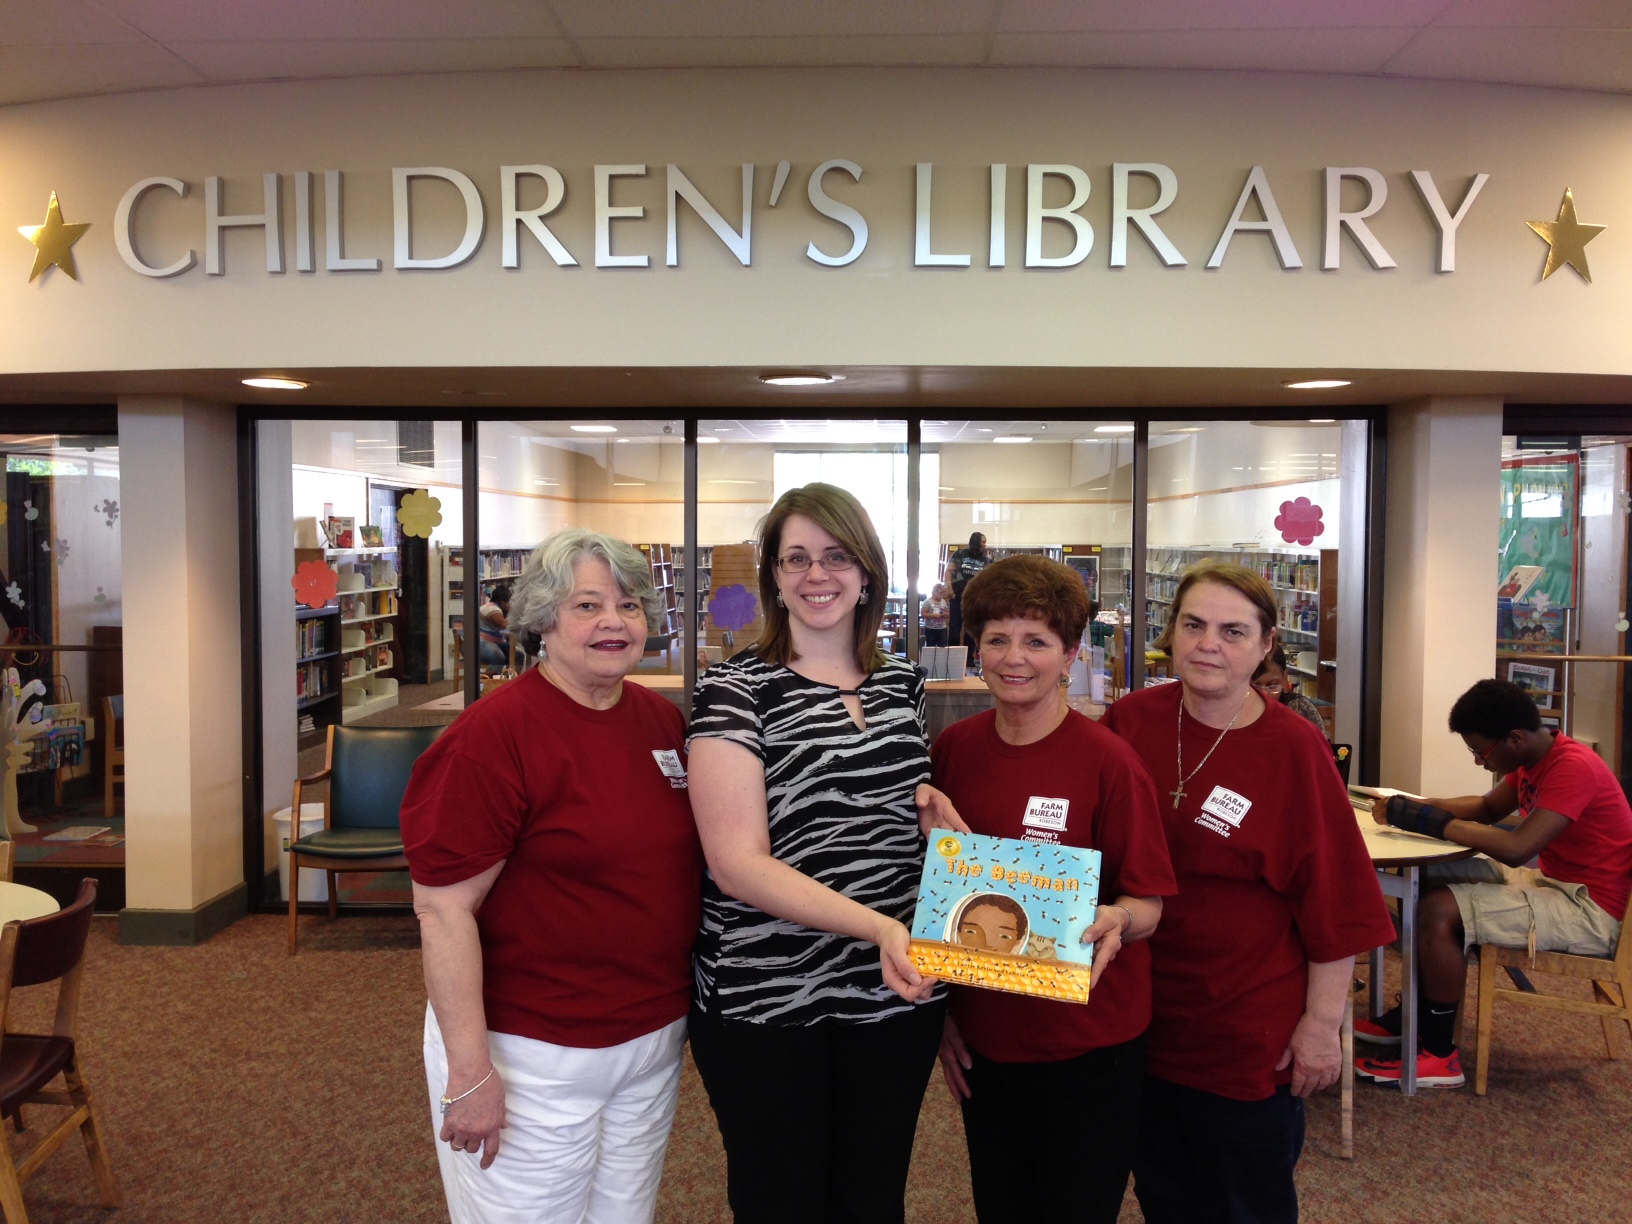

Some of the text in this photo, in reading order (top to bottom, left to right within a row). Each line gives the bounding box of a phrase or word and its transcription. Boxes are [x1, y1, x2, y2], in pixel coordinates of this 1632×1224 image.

[113, 158, 1490, 278] CHILDREN'S LIBRARY
[1040, 802, 1064, 811] FARM
[1211, 796, 1241, 816] BUREAU
[1222, 793, 1245, 810] FARM
[1029, 808, 1062, 819] BUREAU
[1200, 812, 1231, 831] Women's
[1025, 827, 1059, 840] Women's
[1194, 816, 1231, 838] Committee
[945, 857, 1080, 893] The Beeman
